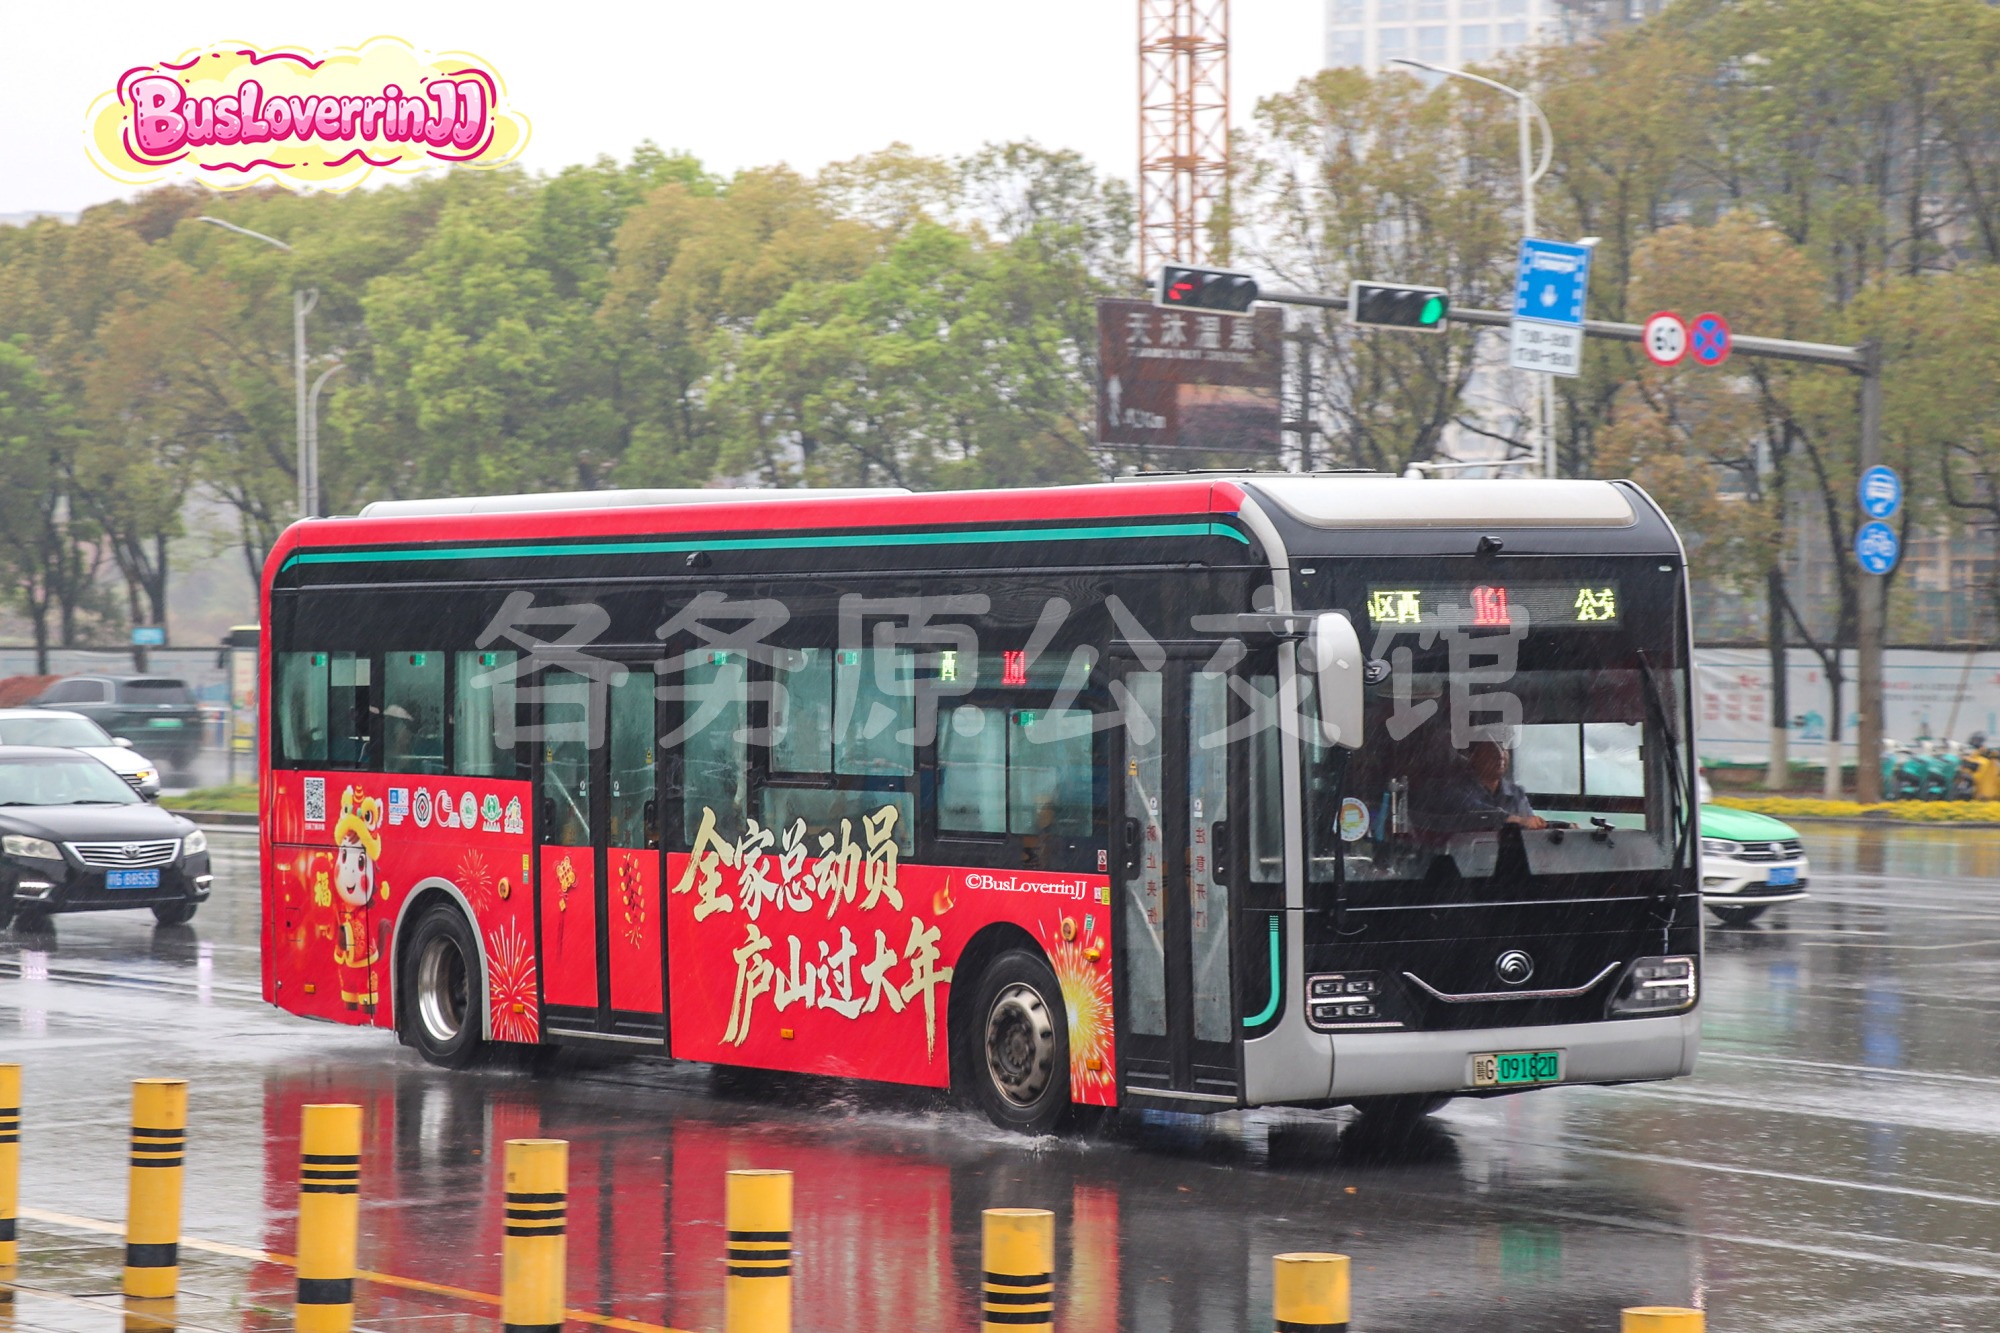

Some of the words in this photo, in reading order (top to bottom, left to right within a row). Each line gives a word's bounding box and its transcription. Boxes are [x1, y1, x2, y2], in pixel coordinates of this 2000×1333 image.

[1367, 591, 1421, 623] 区西
[1473, 587, 1511, 624] 161
[1002, 650, 1026, 684] 161
[673, 805, 903, 921] 全家总动员
[718, 916, 954, 1064] 庐山过大年
